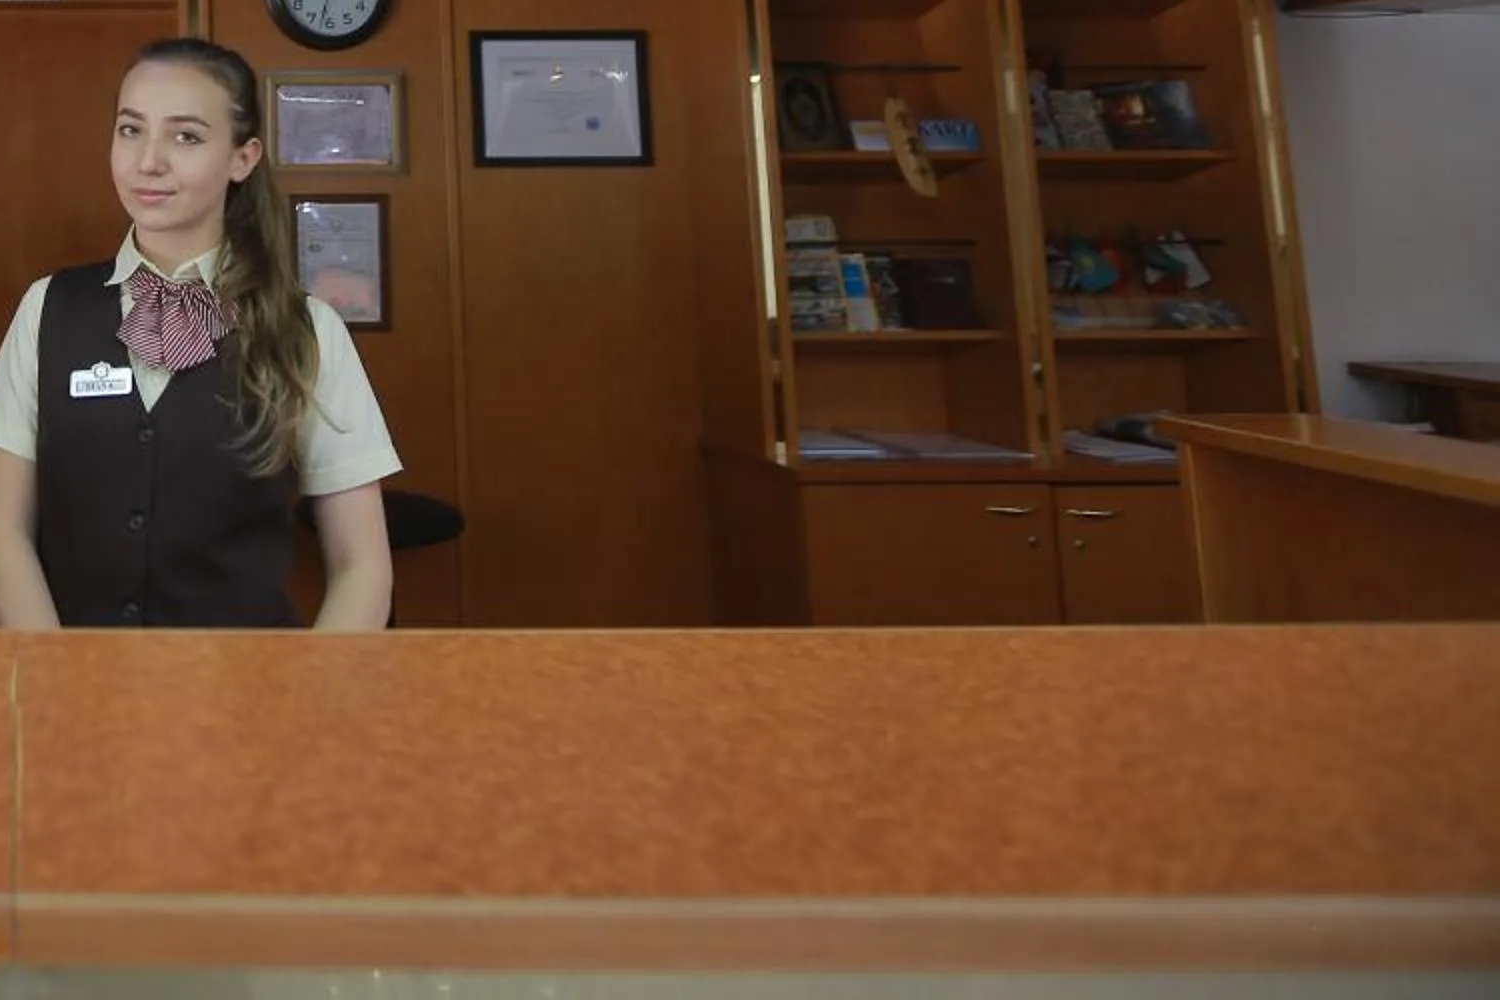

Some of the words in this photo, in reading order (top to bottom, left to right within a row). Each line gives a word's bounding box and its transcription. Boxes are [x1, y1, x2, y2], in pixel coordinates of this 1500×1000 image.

[293, 0, 303, 10] 8
[356, 0, 365, 11] 4
[306, 12, 317, 24] 7
[325, 17, 335, 29] 6
[343, 13, 353, 24] 5
